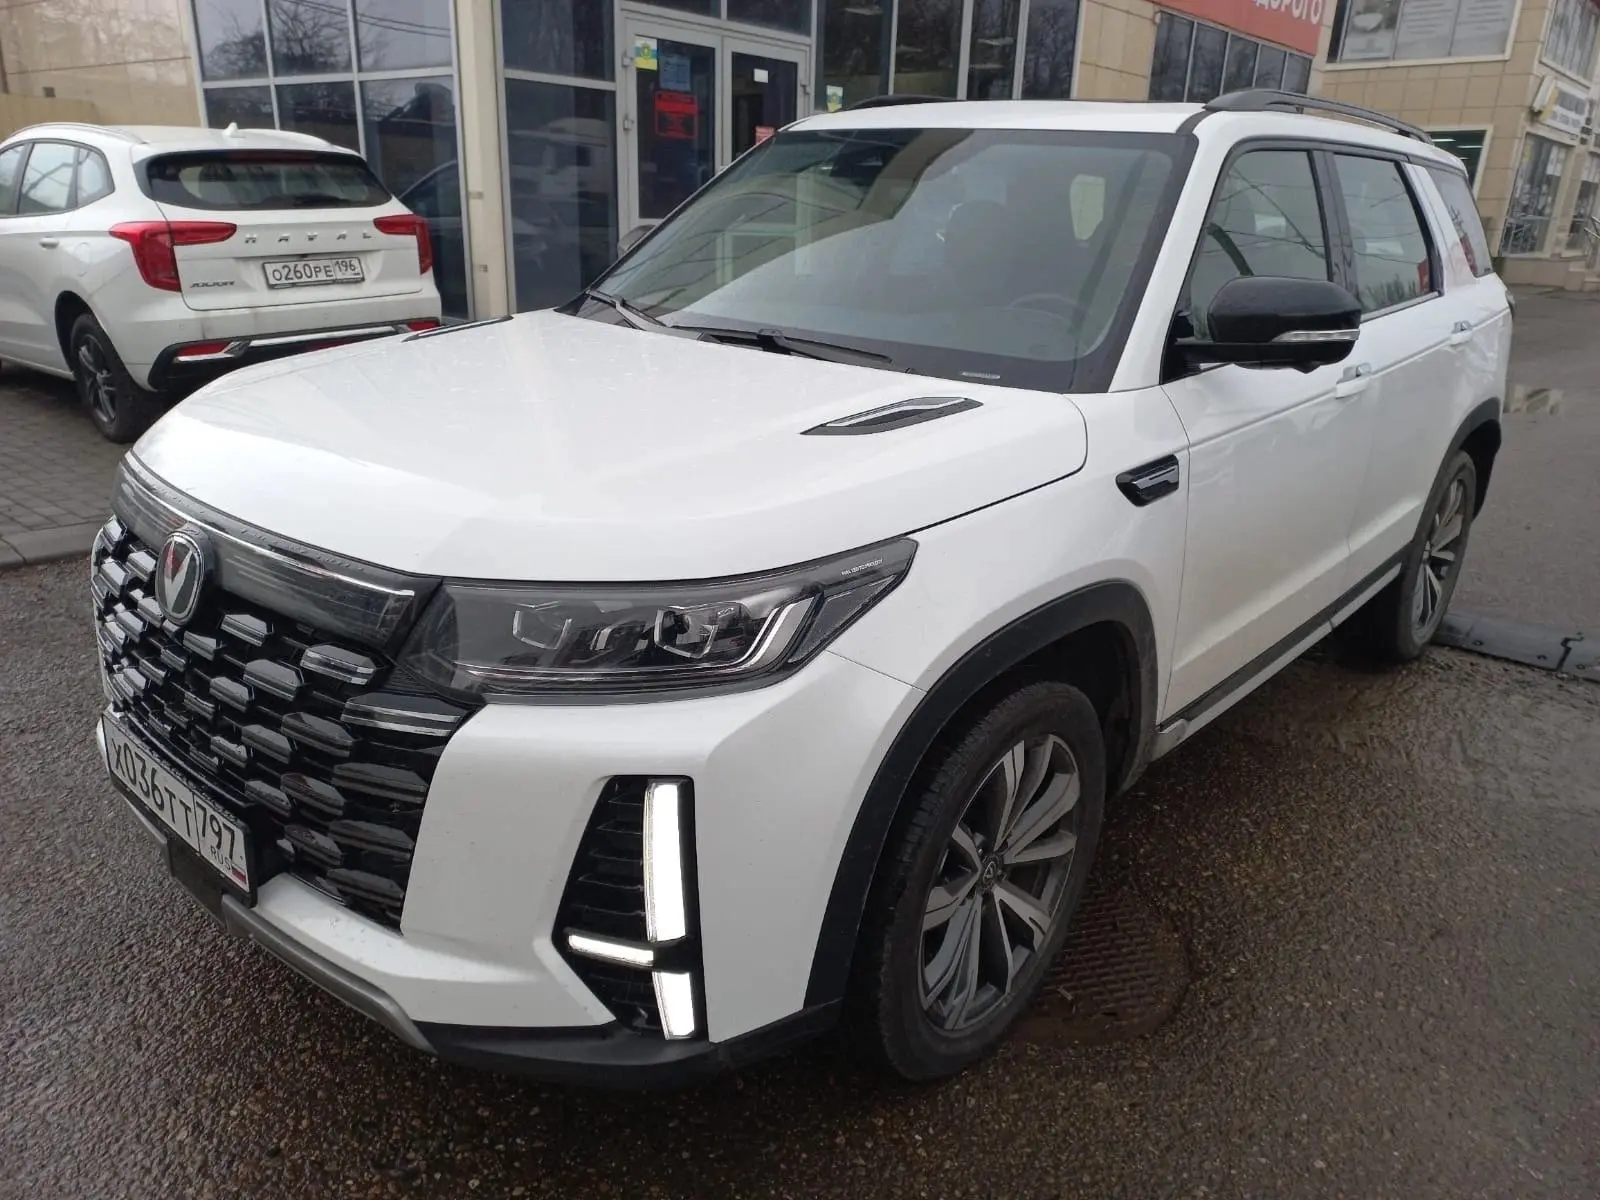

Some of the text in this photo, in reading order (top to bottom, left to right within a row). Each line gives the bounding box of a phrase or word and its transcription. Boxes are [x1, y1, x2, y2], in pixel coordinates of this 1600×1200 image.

[244, 230, 372, 244] HAVAL
[272, 260, 356, 281] О260РЕ 196
[112, 738, 235, 860] Х036ТТ 797
[210, 845, 232, 871] RUS
